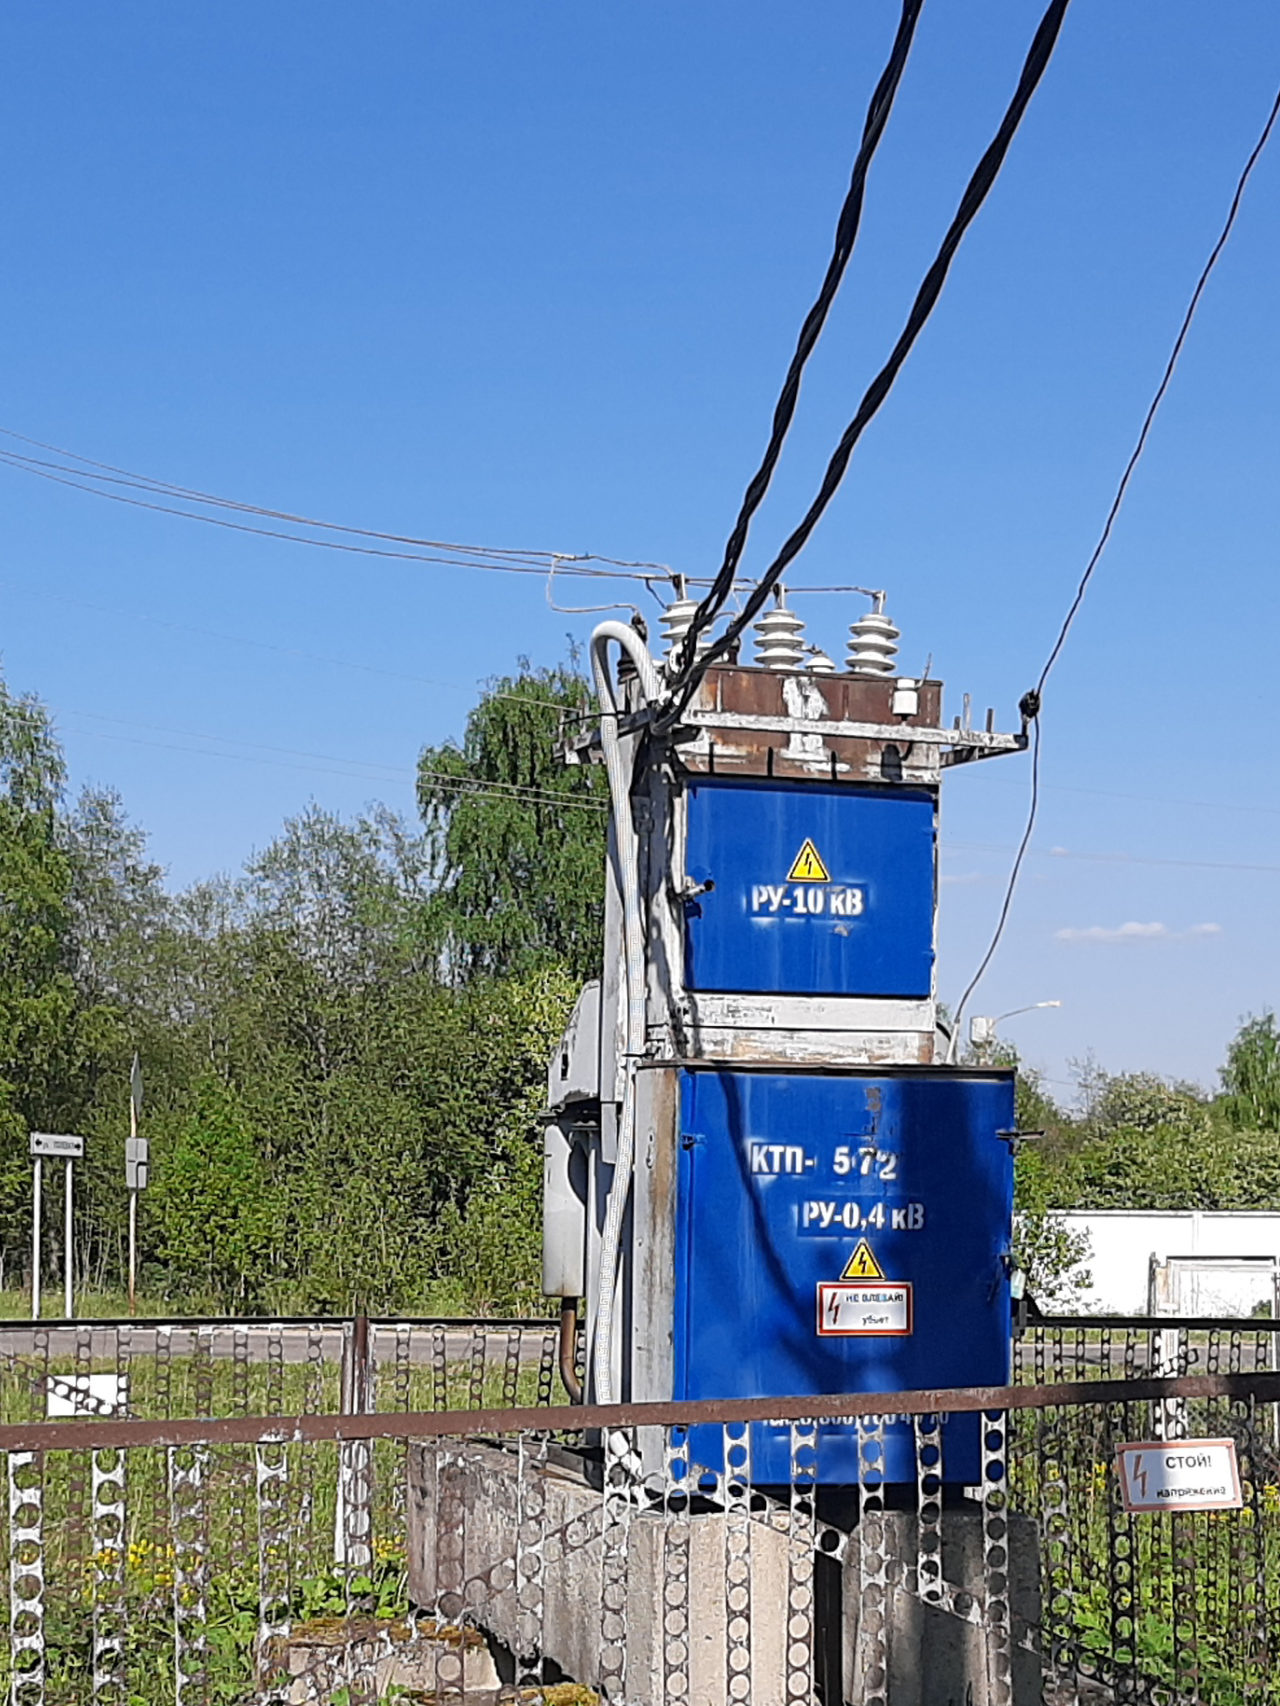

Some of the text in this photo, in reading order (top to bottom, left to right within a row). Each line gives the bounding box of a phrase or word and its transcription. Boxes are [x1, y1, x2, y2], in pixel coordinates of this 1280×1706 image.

[751, 885, 825, 914] РУ-10
[751, 1145, 815, 1174] КТП-
[802, 1201, 886, 1231] РУ-0,4
[1165, 1453, 1212, 1469] СТОЙ!
